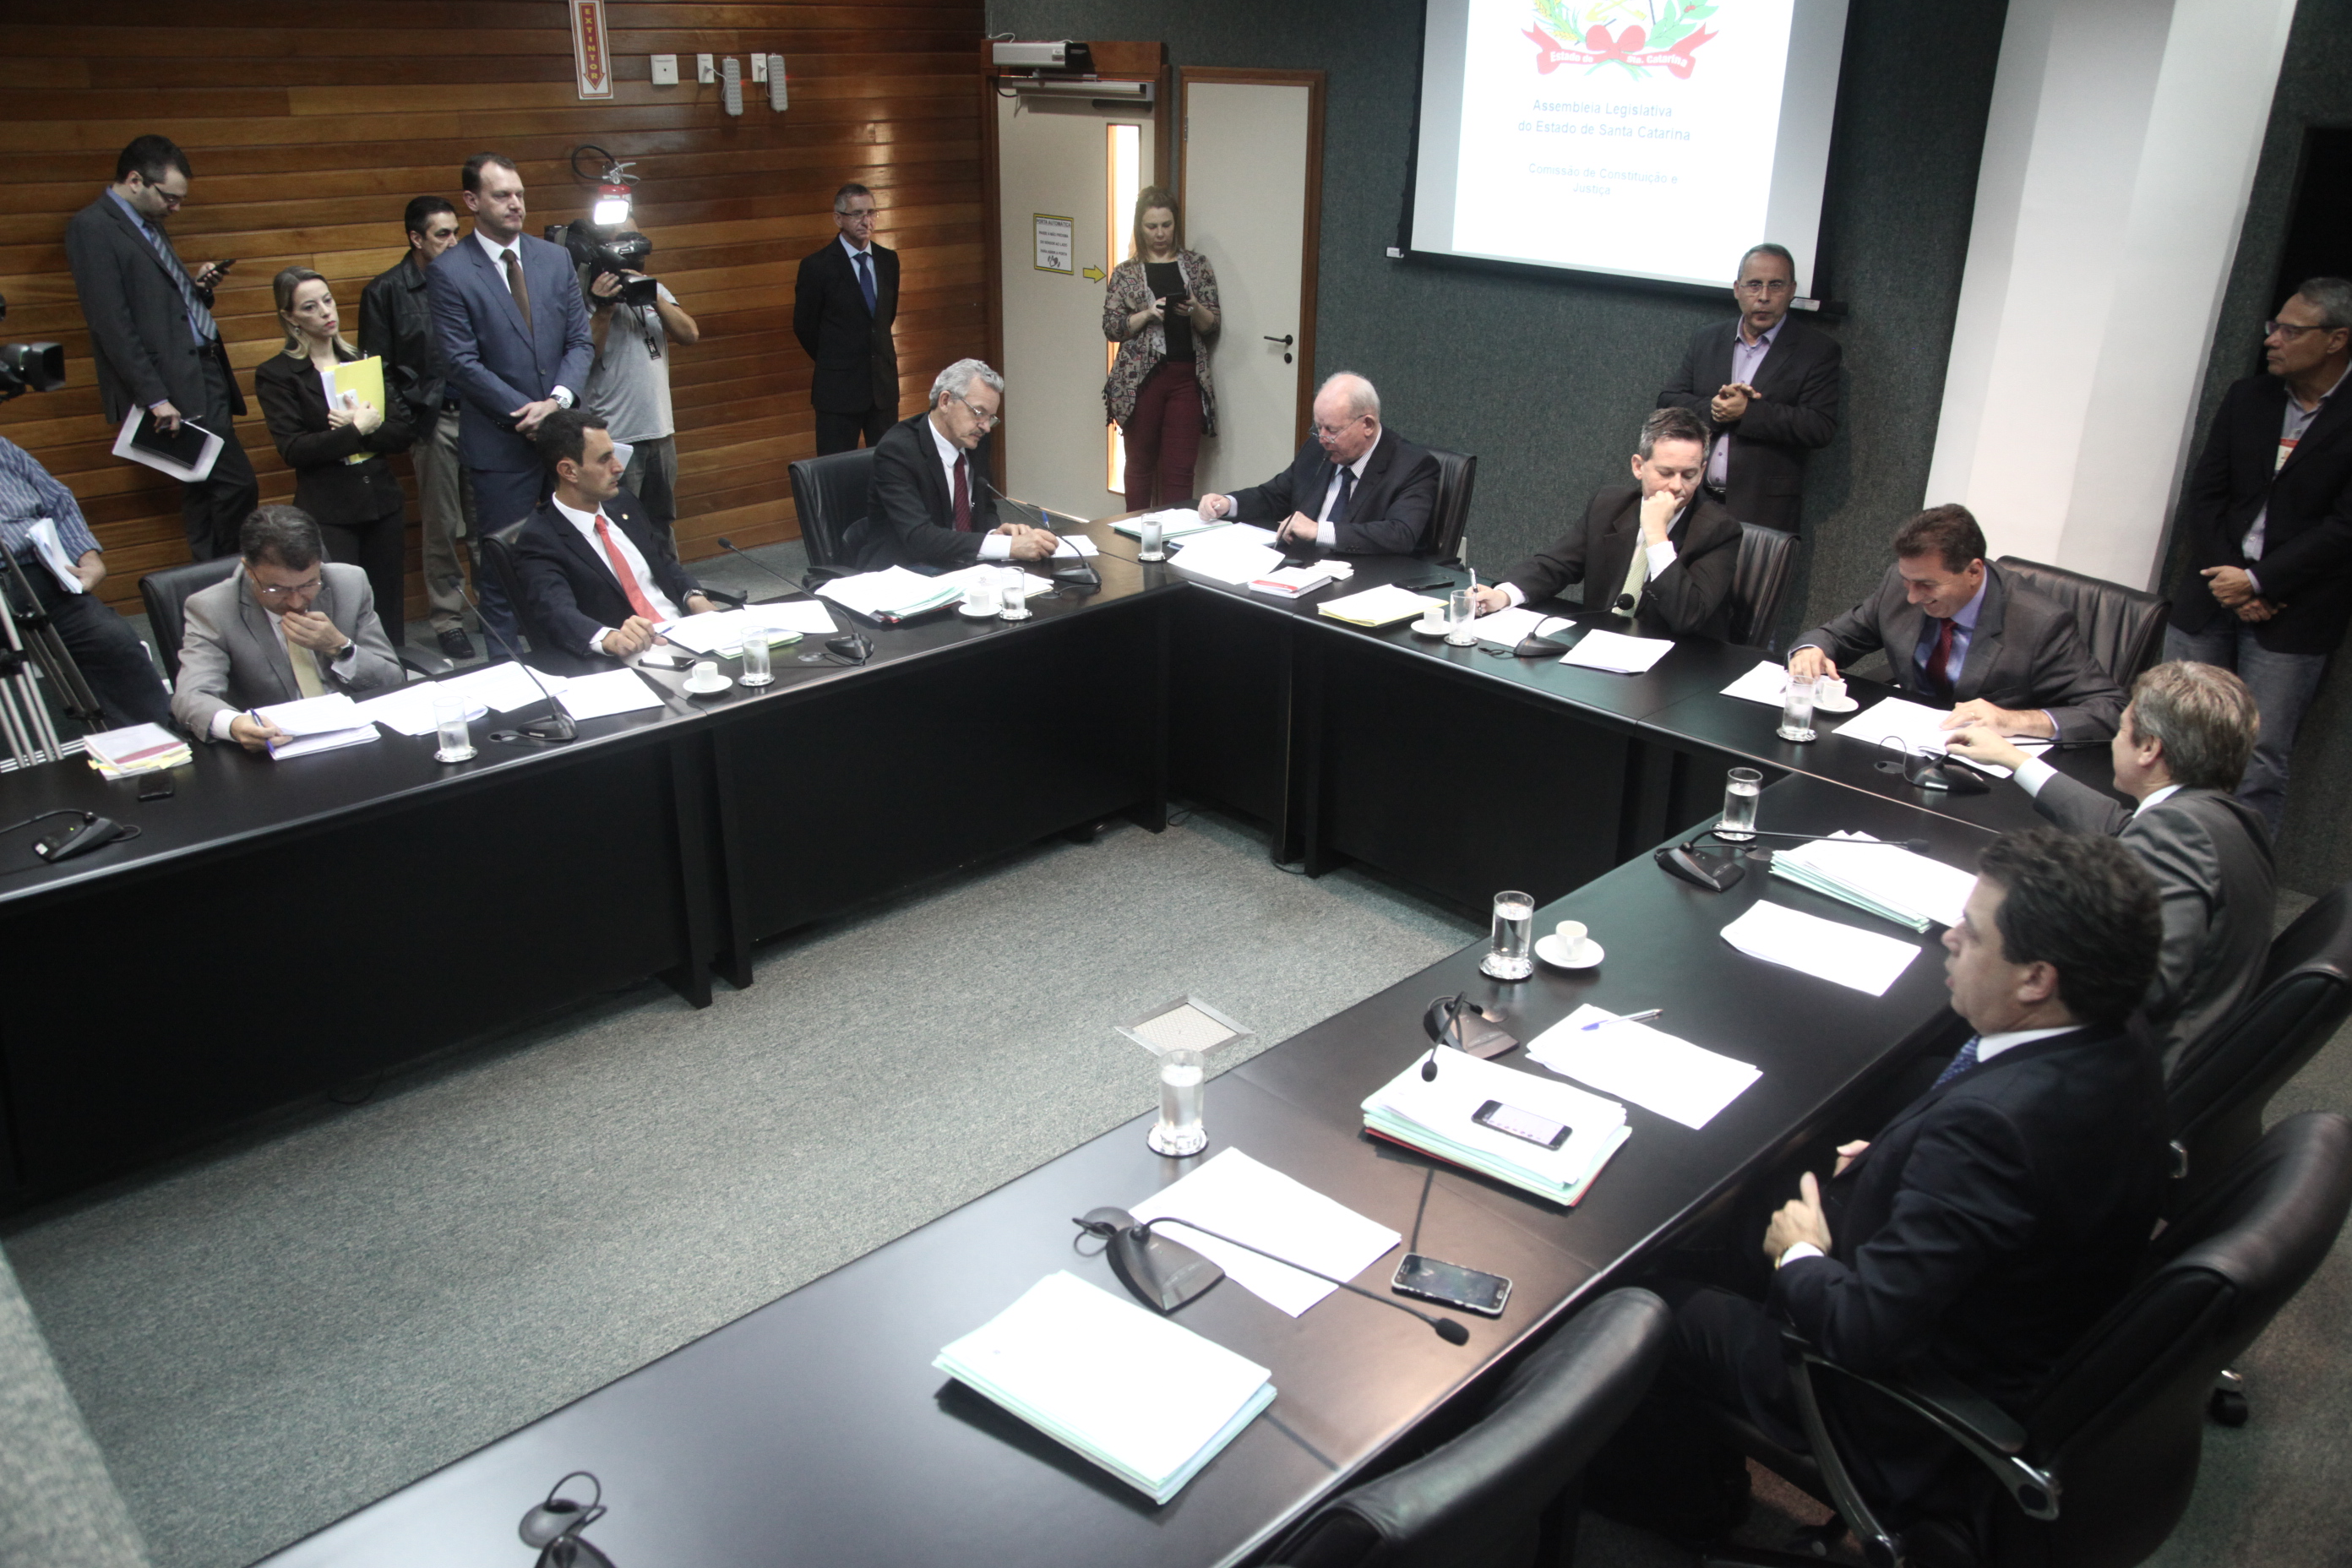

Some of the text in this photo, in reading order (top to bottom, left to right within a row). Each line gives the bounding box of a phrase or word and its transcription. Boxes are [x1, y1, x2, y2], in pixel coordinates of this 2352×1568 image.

[585, 8, 598, 79] EXTINTOR
[1550, 52, 1581, 63] Estado
[1582, 54, 1593, 63] de
[1647, 53, 1688, 67] Catarina
[1533, 100, 1672, 118] Assembleia Legislativa
[1518, 121, 1690, 141] do Estado de Santa Catarina
[1528, 163, 1679, 185] Comissão de Constituição e
[1573, 182, 1611, 197] Justiça
